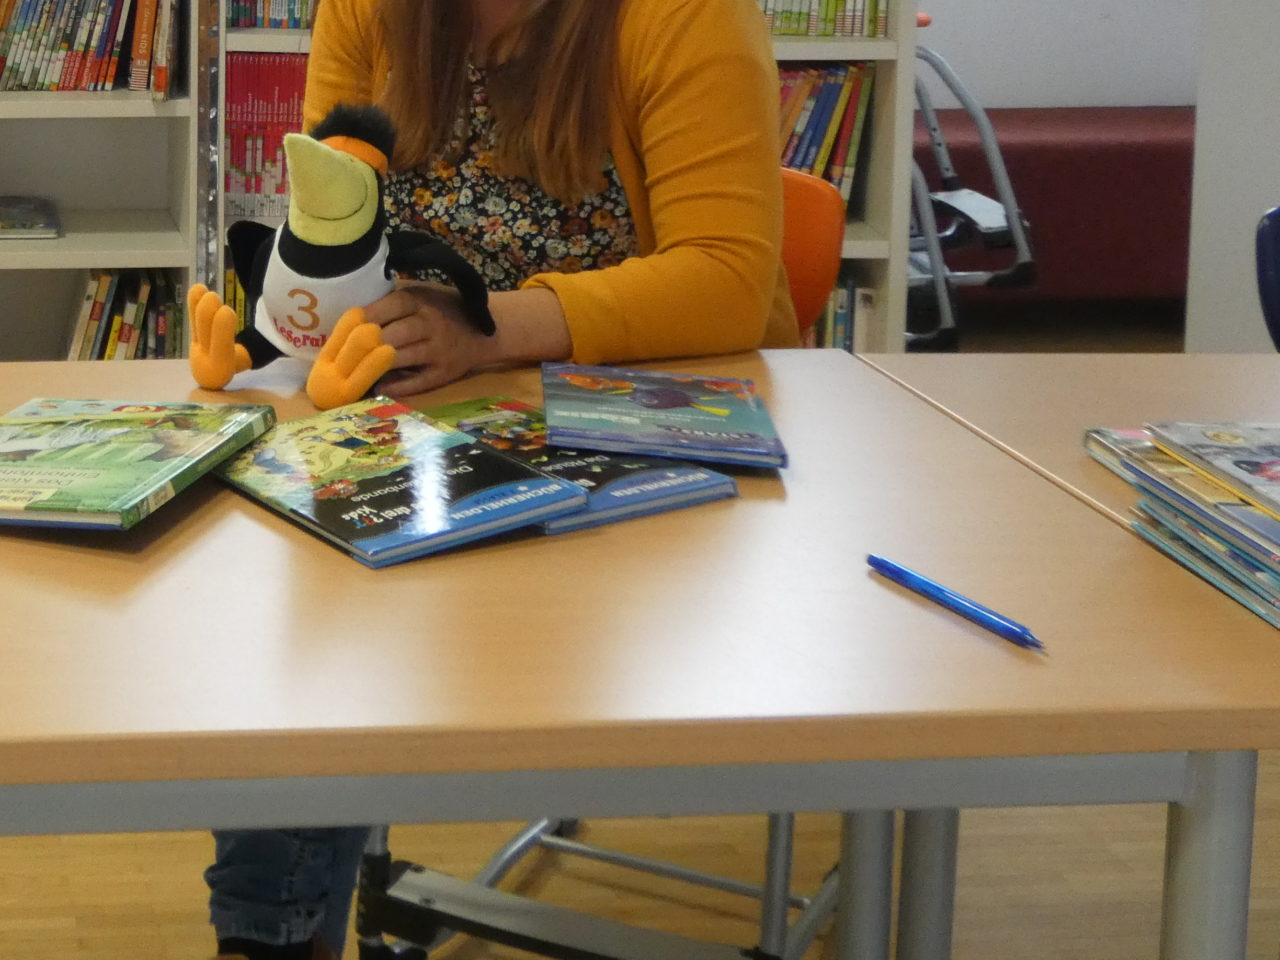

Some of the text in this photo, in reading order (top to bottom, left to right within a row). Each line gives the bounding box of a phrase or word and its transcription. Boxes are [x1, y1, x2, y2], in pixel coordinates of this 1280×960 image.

[286, 288, 321, 331] 3
[446, 464, 473, 476] Die
[450, 483, 562, 520] BÜCHERHELDEN
[341, 505, 377, 521] Kids
[381, 503, 411, 519] drei
